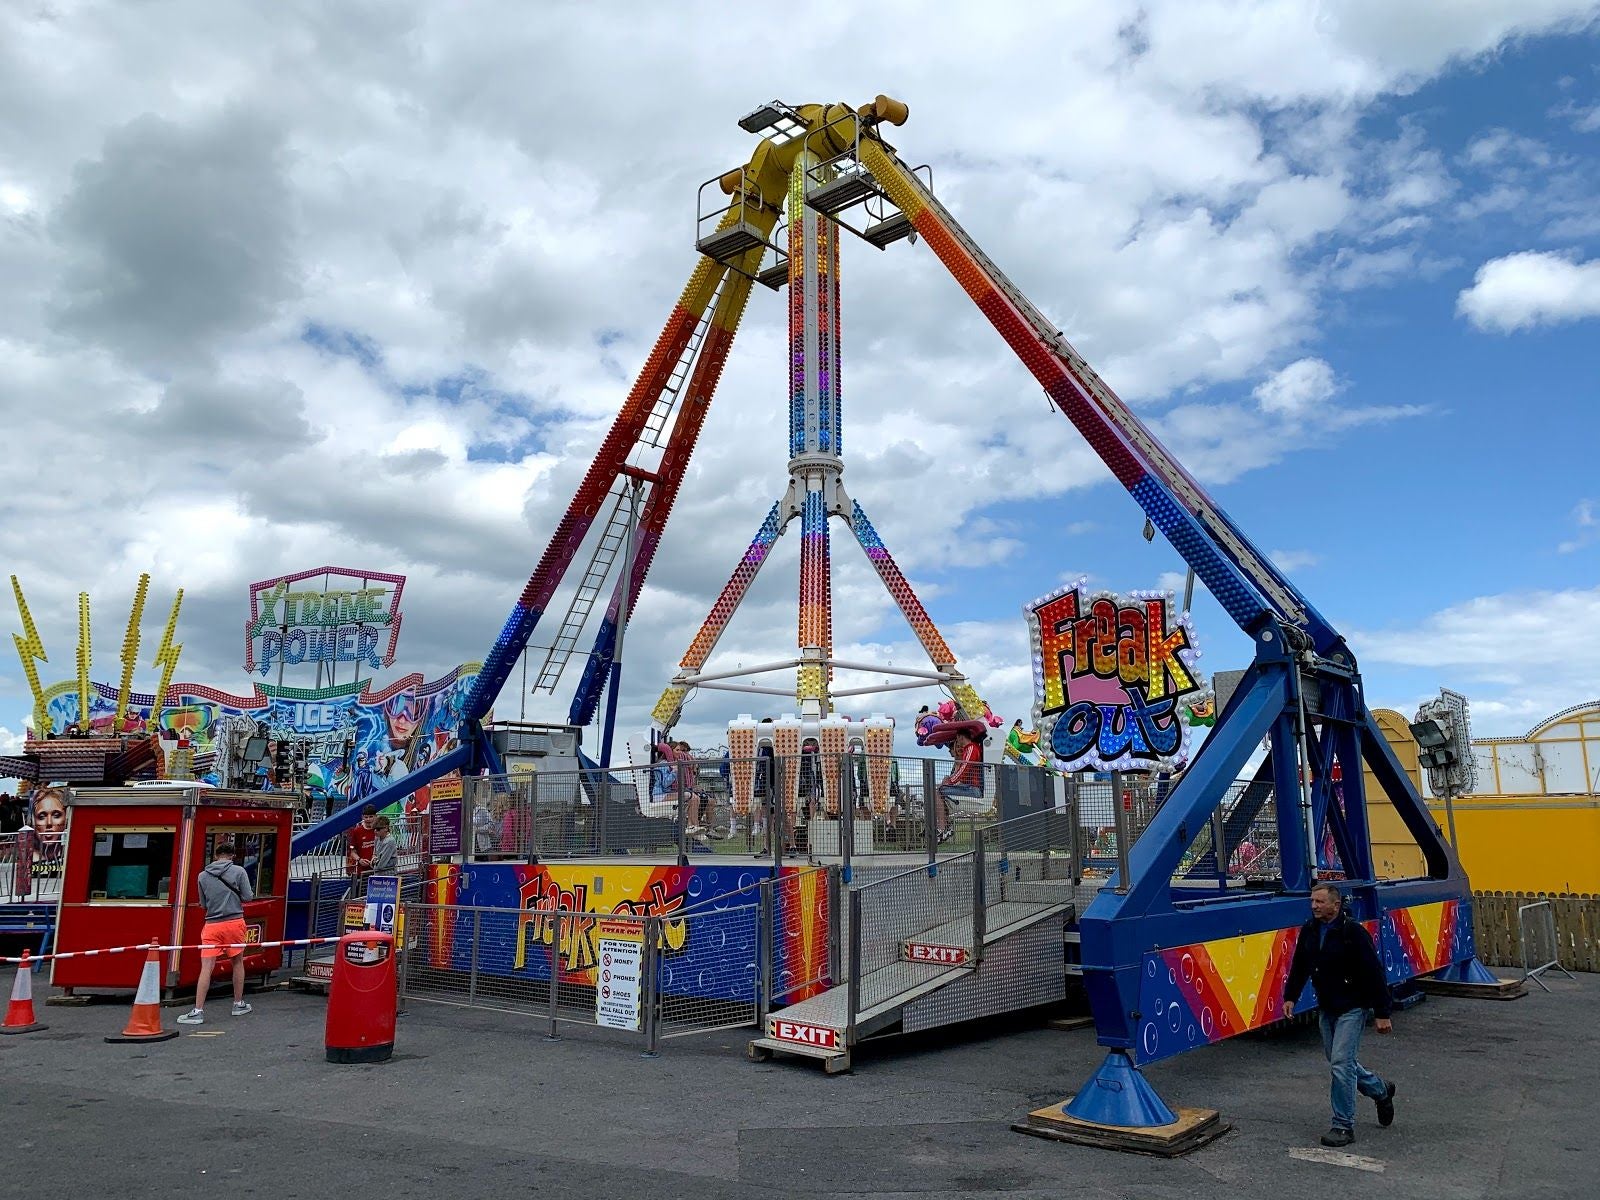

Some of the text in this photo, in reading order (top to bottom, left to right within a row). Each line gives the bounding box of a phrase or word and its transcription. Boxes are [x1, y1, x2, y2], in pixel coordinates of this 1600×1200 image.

[251, 579, 393, 638] XTREME
[260, 625, 380, 677] POWER
[1034, 591, 1196, 713] Freak
[294, 702, 335, 732] ICE
[603, 947, 638, 955] ATTENTION
[913, 946, 961, 962] EXIT
[613, 974, 636, 982] PHONES
[612, 990, 631, 998] SHOES
[613, 1007, 624, 1015] FALL
[779, 1023, 831, 1045] EXIT
